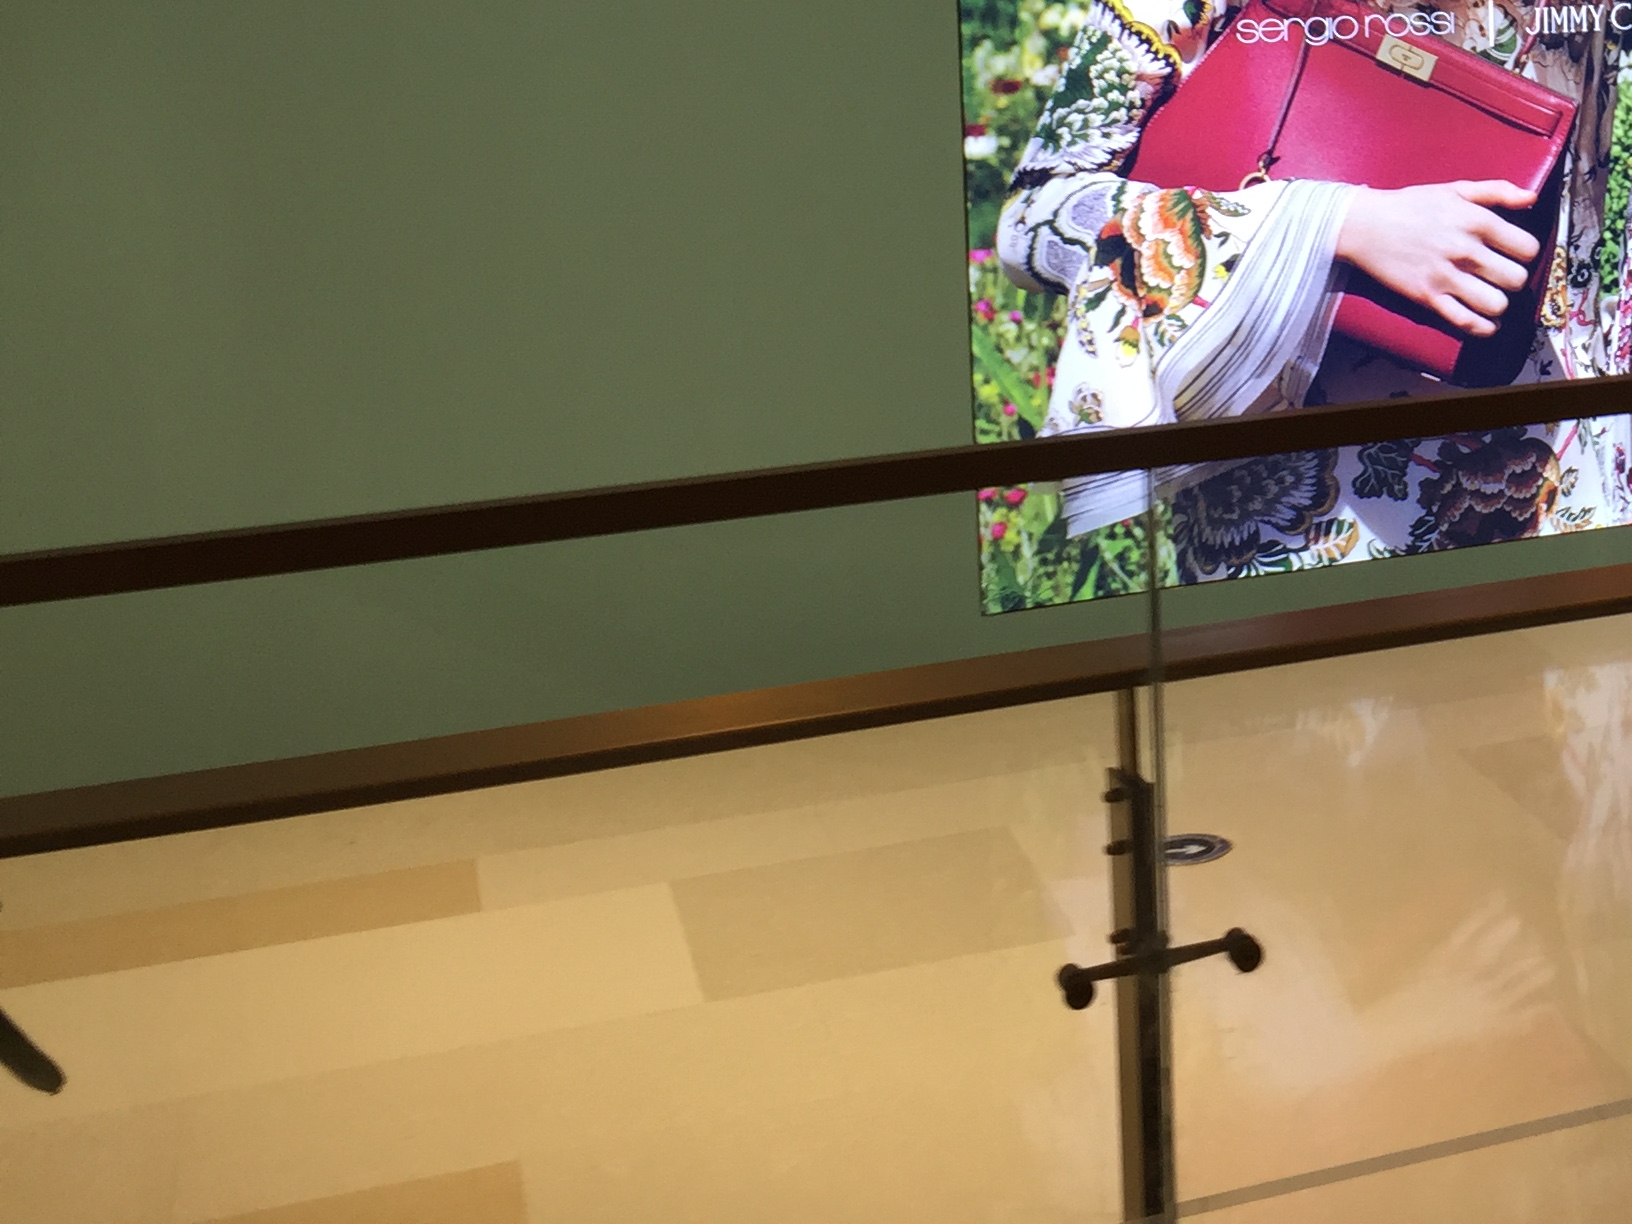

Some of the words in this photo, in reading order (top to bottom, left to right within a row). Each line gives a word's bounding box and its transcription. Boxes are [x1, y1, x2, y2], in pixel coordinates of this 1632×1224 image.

[1235, 15, 1359, 46] sergio
[1364, 11, 1455, 40] rossi
[1525, 4, 1603, 36] JIMMY
